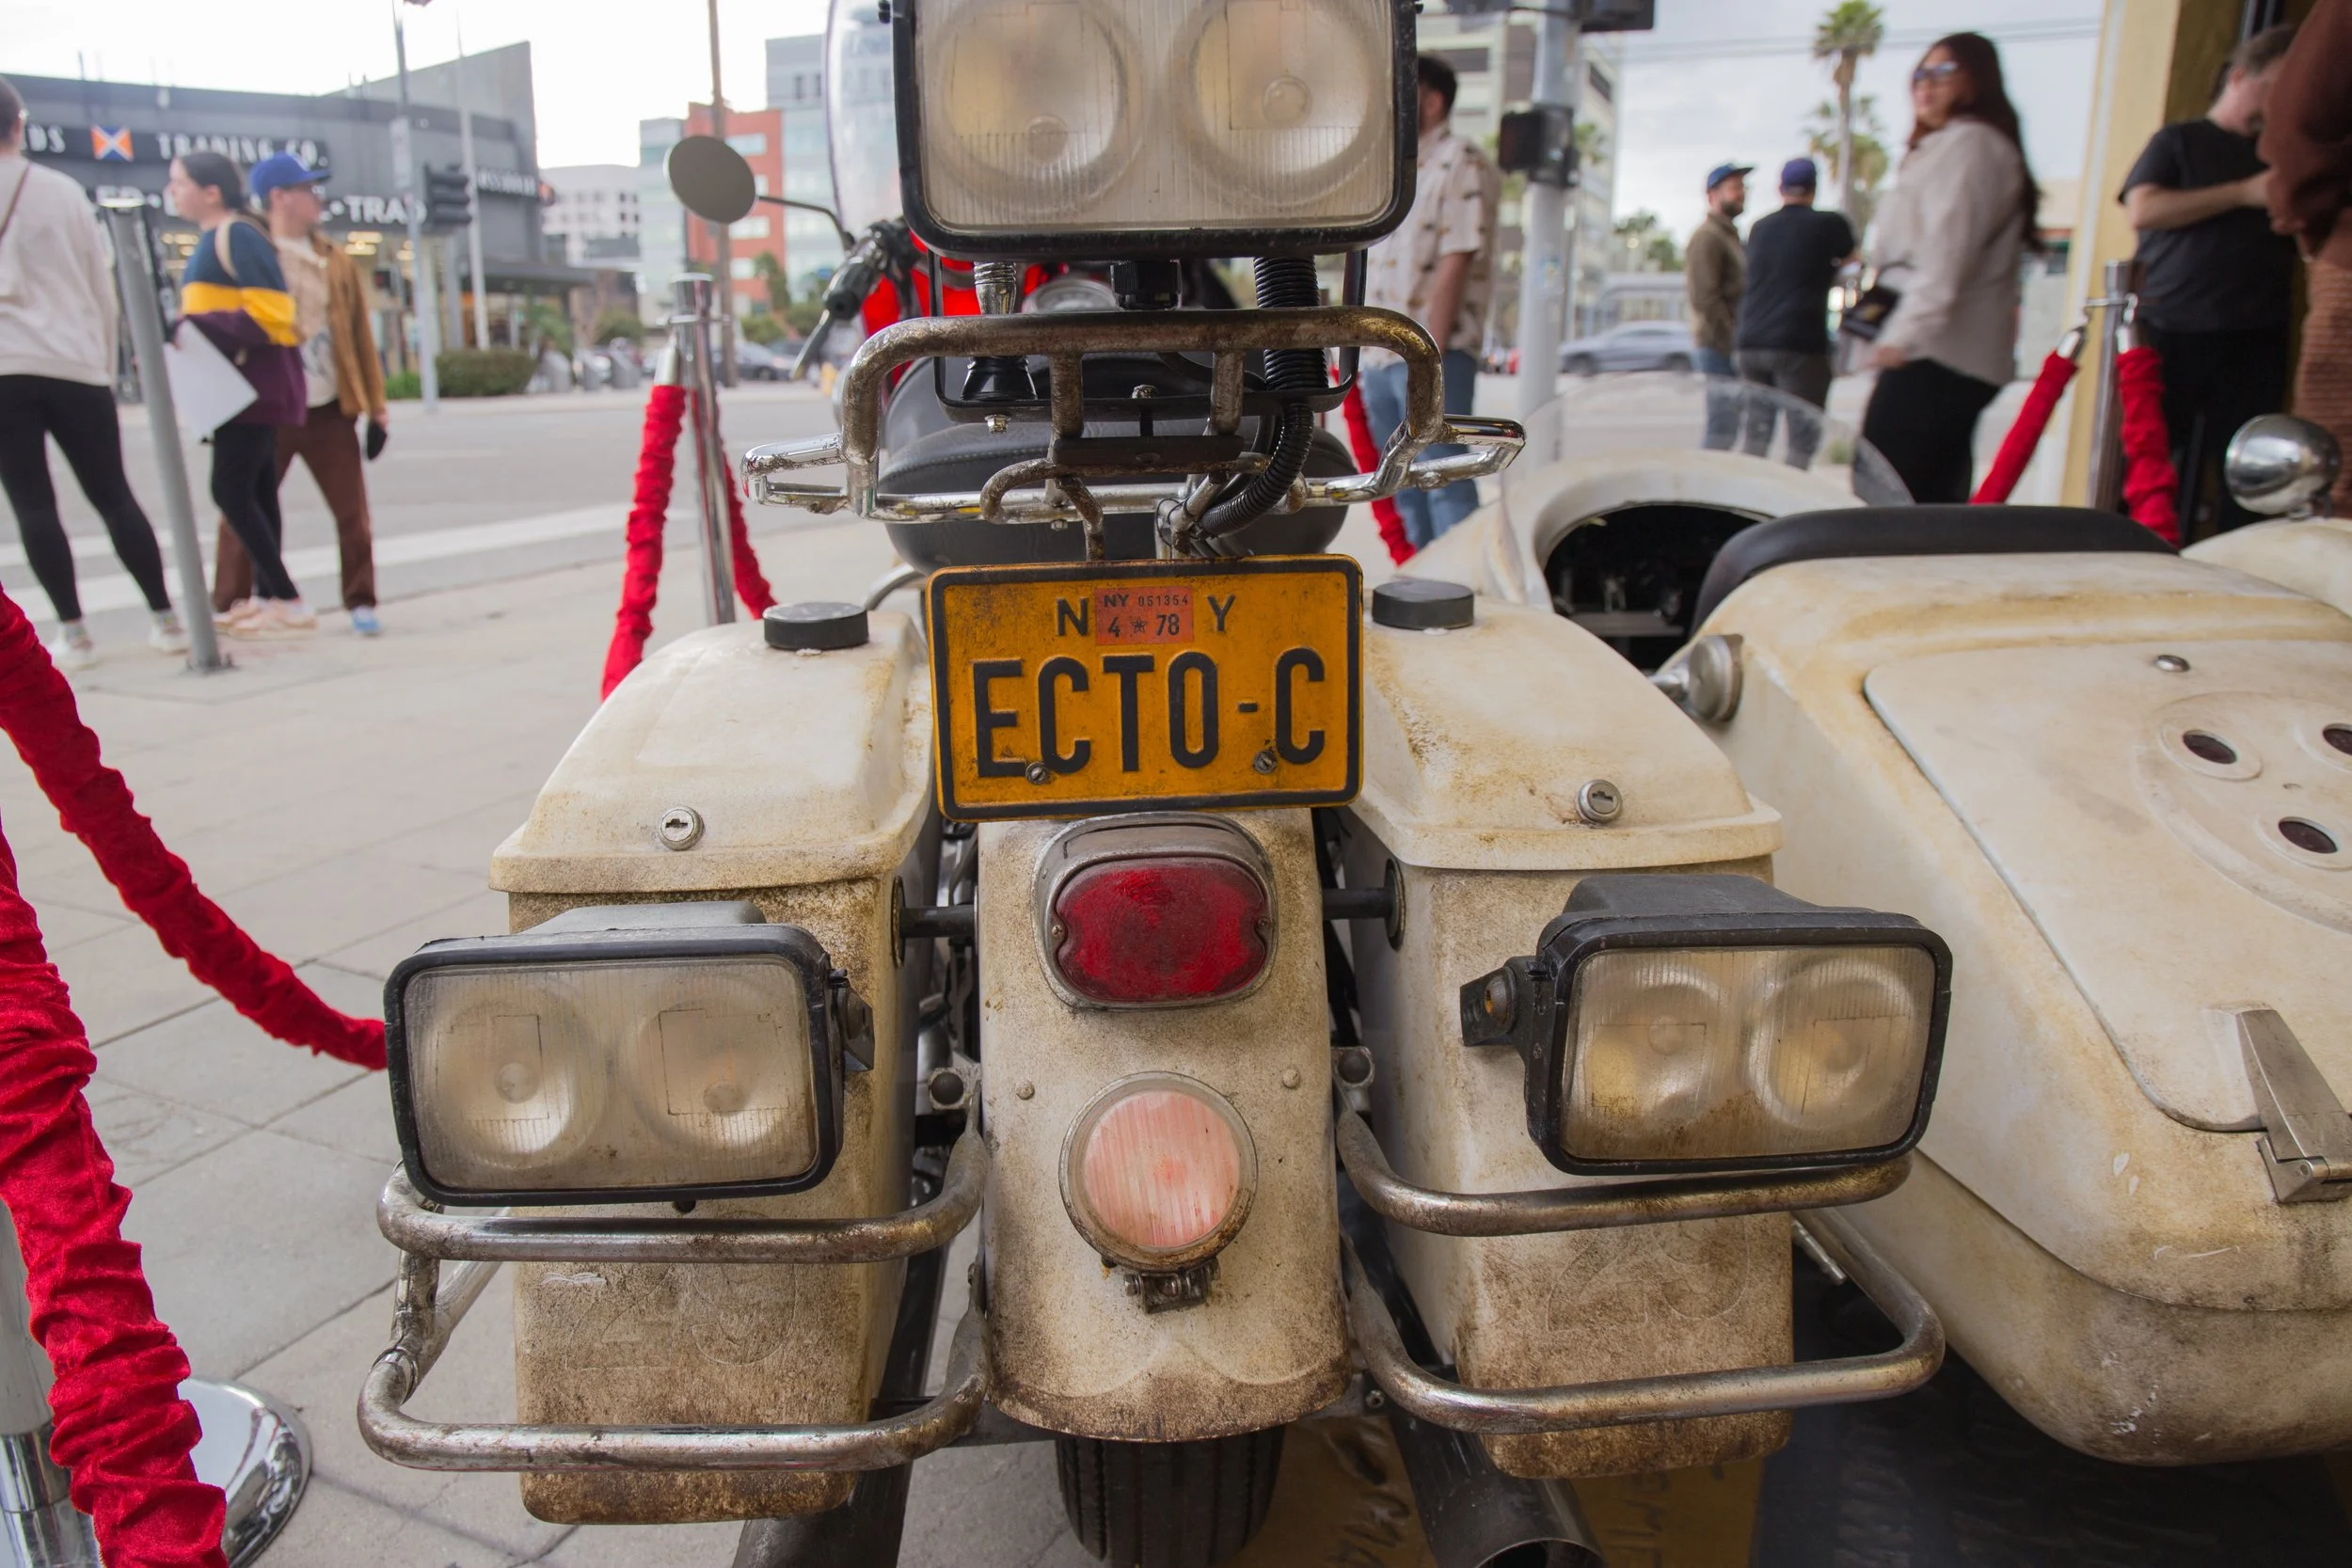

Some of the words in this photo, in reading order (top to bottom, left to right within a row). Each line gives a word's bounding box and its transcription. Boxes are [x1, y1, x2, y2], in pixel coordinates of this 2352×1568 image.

[1056, 596, 1089, 638] N
[1207, 594, 1236, 633] Y
[1104, 593, 1130, 608] NY
[1137, 594, 1188, 608] 051354
[1107, 616, 1121, 639] 4
[1155, 612, 1181, 637] 78
[972, 647, 1327, 779] ECTO-C
